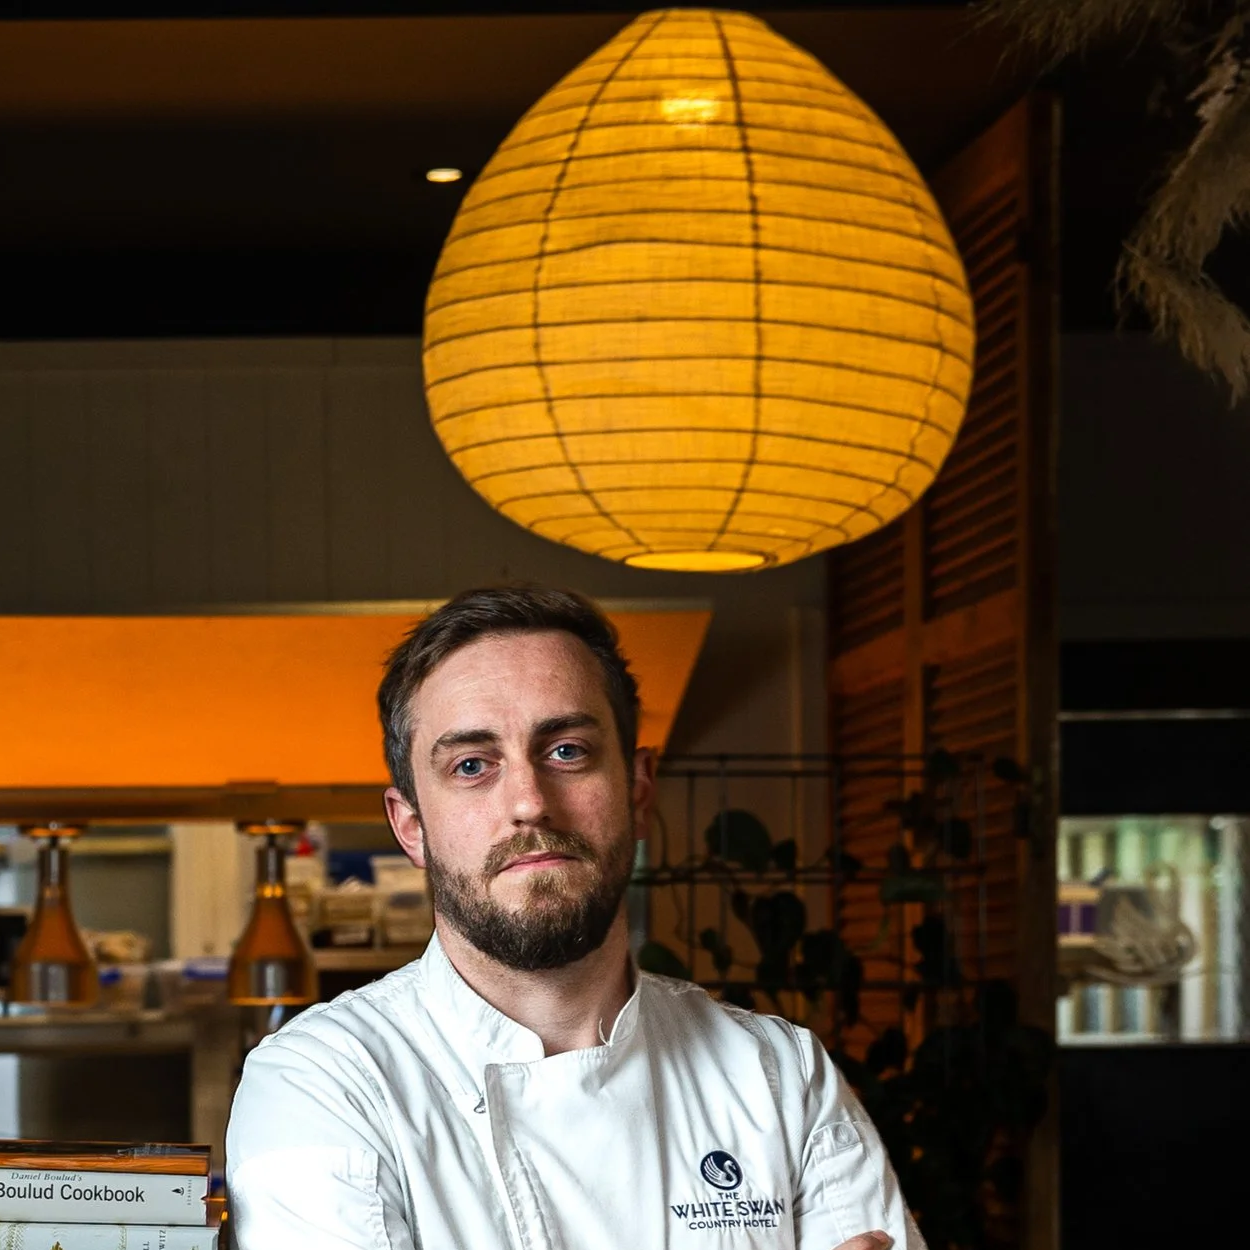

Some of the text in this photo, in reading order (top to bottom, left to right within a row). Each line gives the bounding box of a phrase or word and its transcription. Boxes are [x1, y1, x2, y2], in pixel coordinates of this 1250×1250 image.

[11, 1173, 83, 1182] Daniel Boulud's
[60, 1184, 145, 1202] Cookbook
[717, 1192, 740, 1201] THE
[671, 1198, 786, 1219] WHITE SWAN
[688, 1218, 778, 1231] COUNTRY HOTEL
